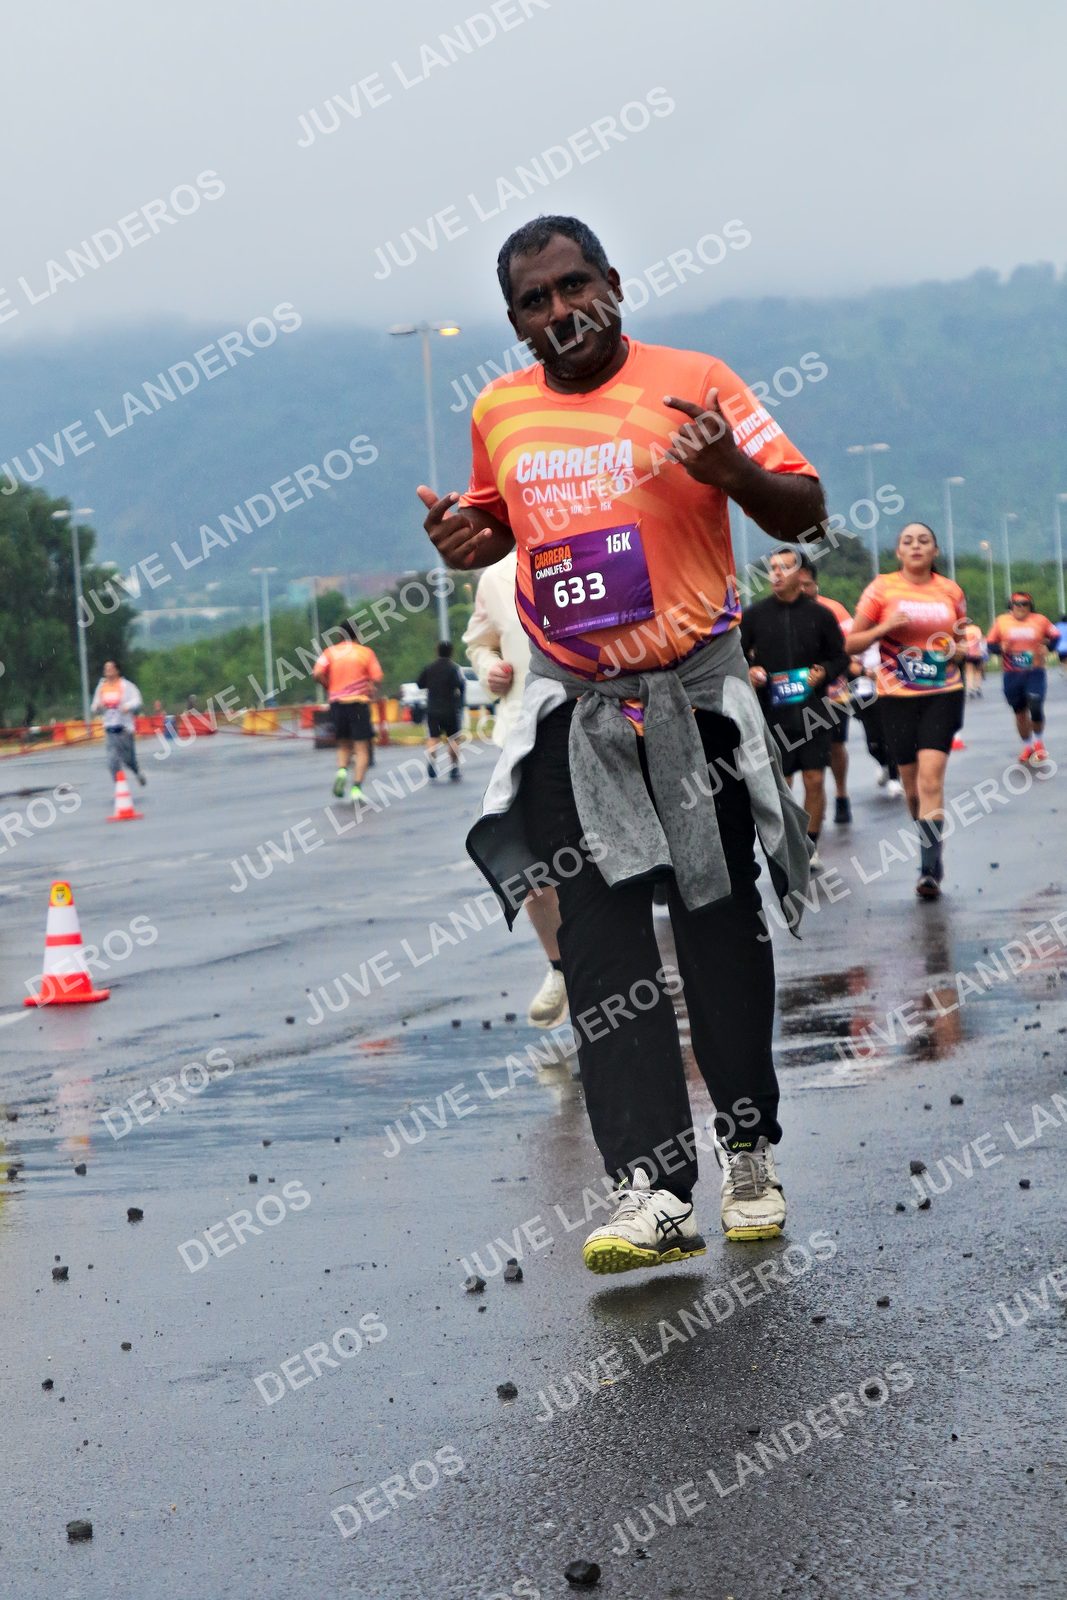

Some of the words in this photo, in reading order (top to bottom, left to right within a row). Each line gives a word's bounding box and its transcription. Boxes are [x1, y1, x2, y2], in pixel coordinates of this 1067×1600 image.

[516, 439, 633, 484] CARRERA
[522, 477, 608, 506] OMNILIFE
[534, 544, 572, 569] CARRERA
[606, 532, 632, 554] 15K
[536, 564, 564, 580] OMNILIFE
[554, 572, 606, 608] 633
